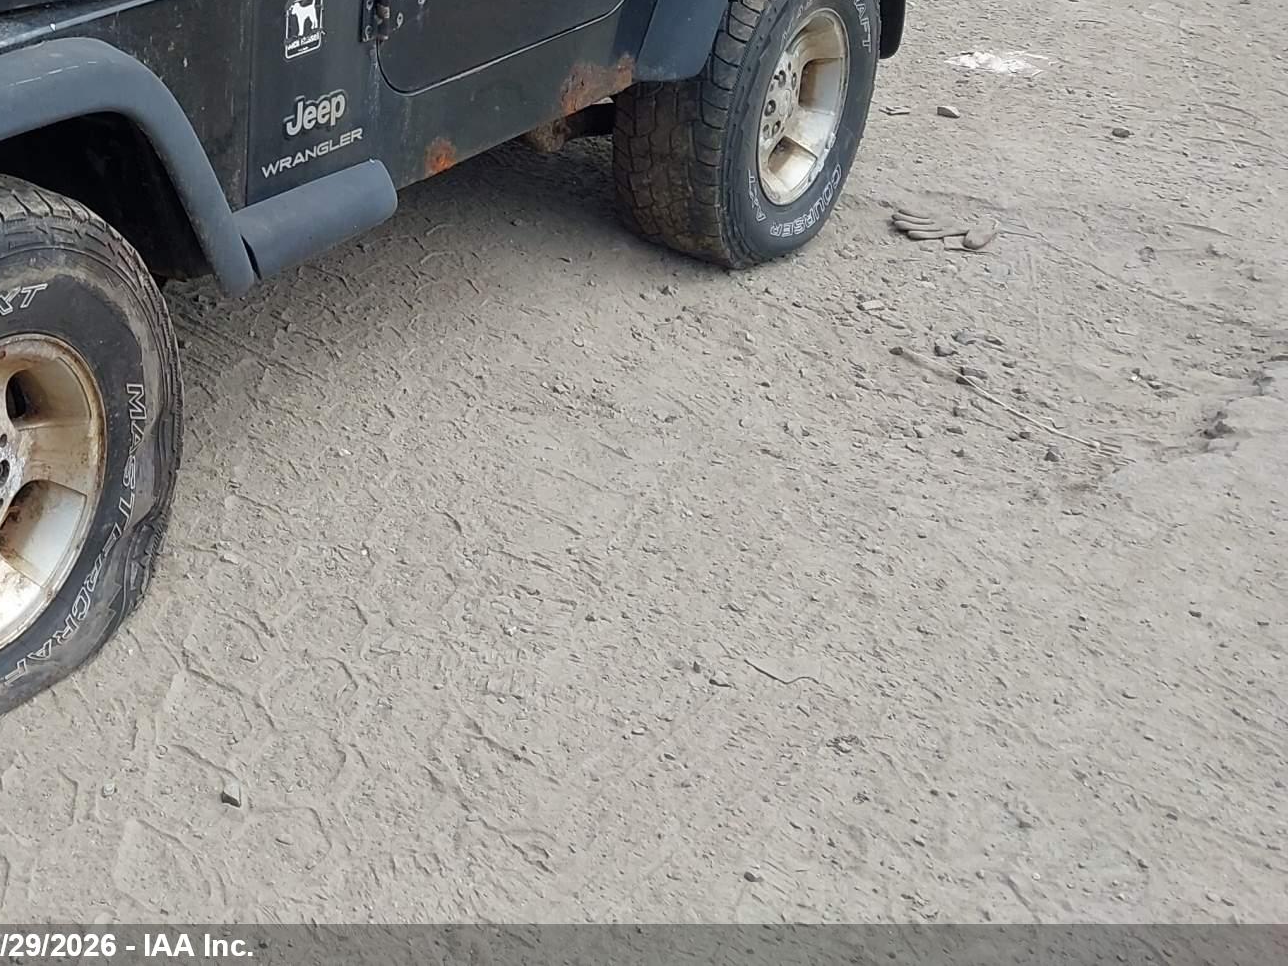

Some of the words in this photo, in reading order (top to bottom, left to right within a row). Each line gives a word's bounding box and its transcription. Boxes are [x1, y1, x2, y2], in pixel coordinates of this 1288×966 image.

[285, 92, 346, 137] Jeep
[261, 128, 364, 179] WRANGLER
[770, 163, 842, 238] COURSER
